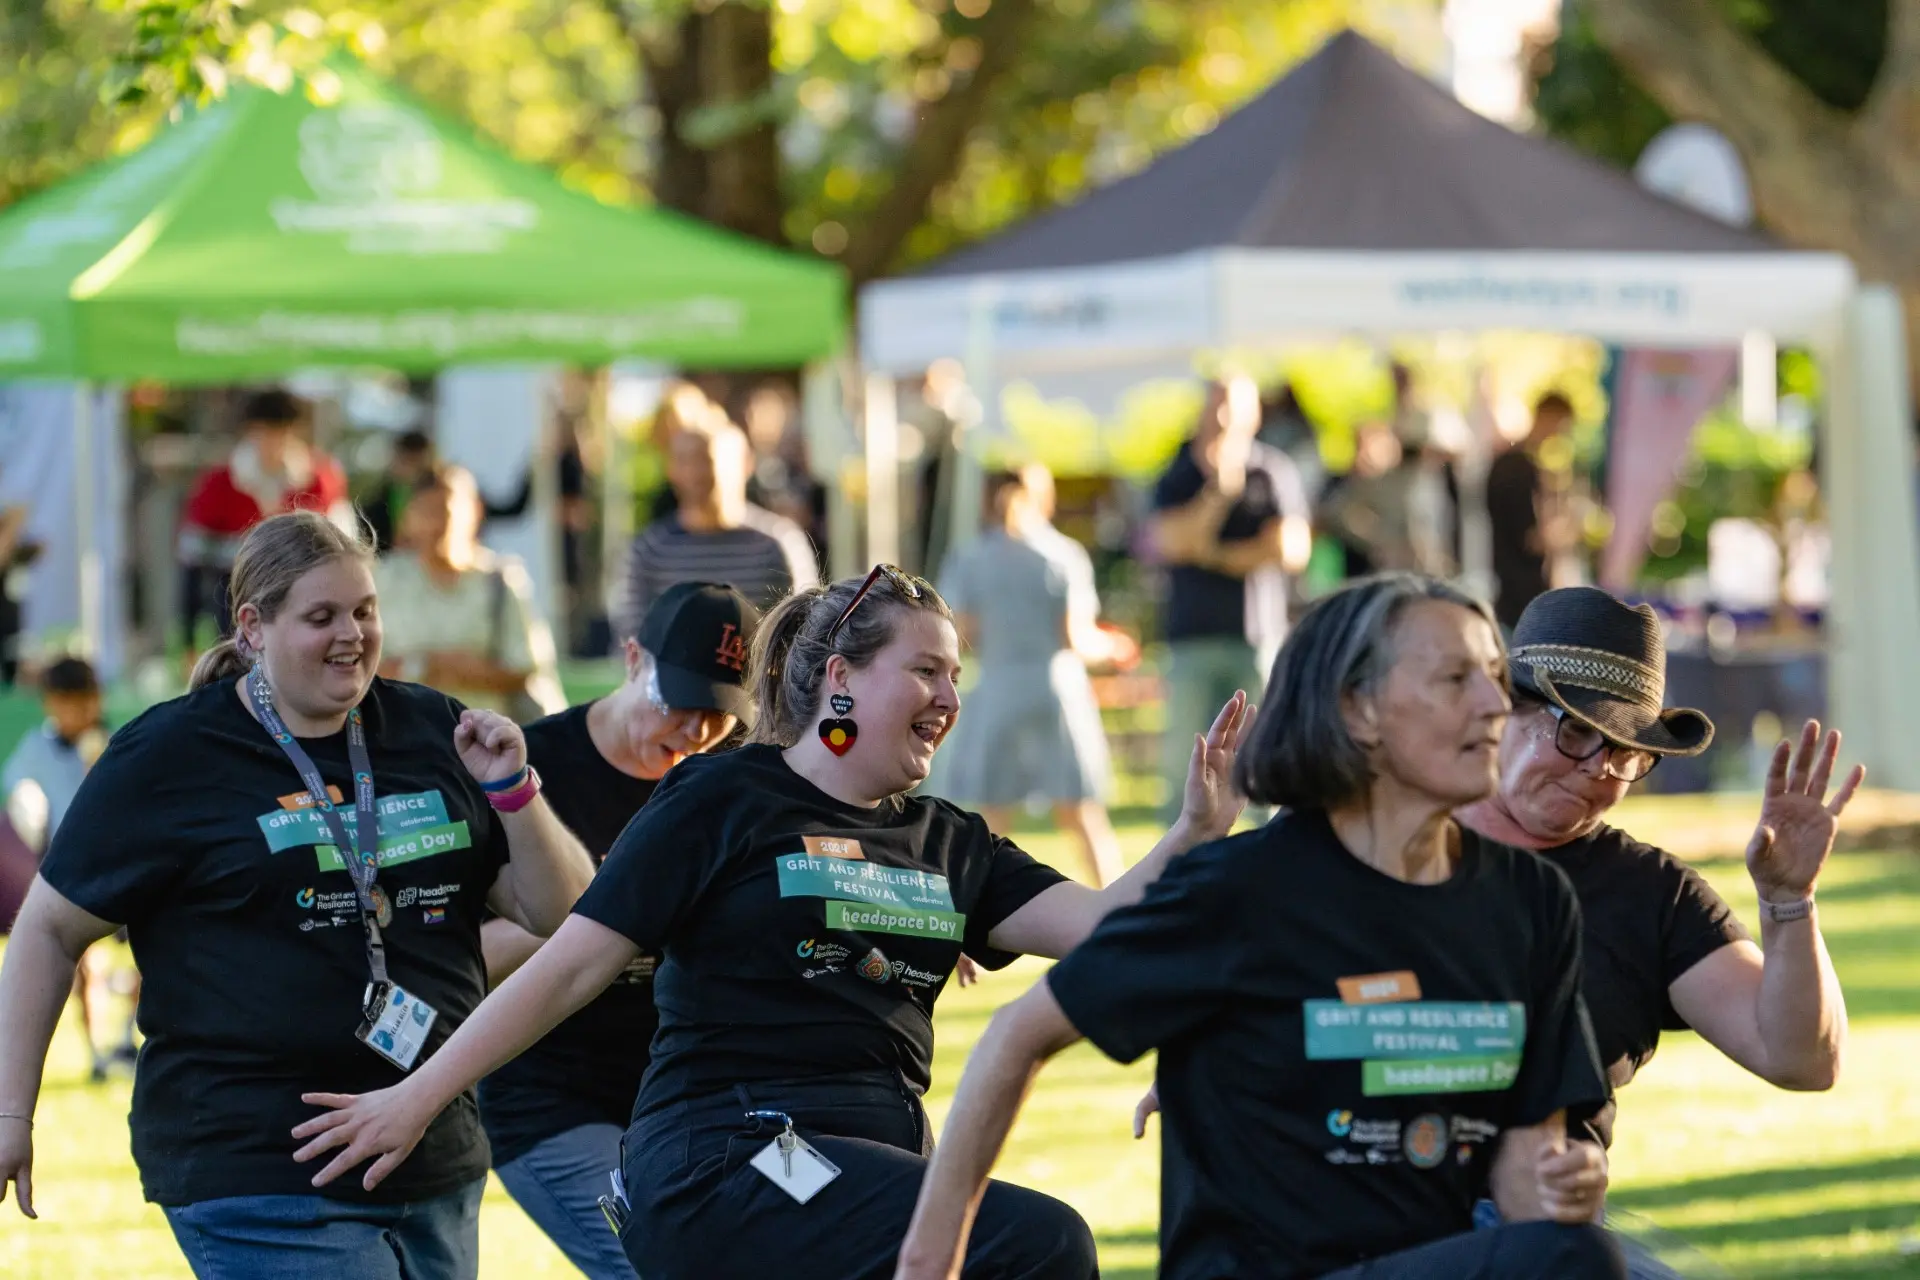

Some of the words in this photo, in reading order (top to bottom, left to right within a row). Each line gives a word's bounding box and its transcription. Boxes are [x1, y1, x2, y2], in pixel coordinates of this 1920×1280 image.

[715, 623, 745, 671] LA
[832, 698, 852, 706] ALWAYS
[835, 704, 848, 712] WAS
[269, 813, 303, 828] GRIT
[340, 798, 428, 823] REIENCE
[400, 815, 437, 828] celebrates
[332, 842, 418, 866] hpace
[421, 832, 456, 850] Day
[820, 841, 849, 854] 2024
[786, 859, 822, 872] GRIT
[828, 862, 856, 876] AND
[860, 867, 937, 890] RESILIENCE
[330, 892, 343, 900] Grit
[343, 891, 356, 899] and
[834, 880, 900, 902] FESTIVAL
[317, 901, 357, 910] Resilience
[842, 906, 925, 930] headspace
[929, 915, 956, 937] Day
[1315, 1008, 1360, 1027] GRIT
[1367, 1009, 1406, 1027] AND
[1409, 1009, 1509, 1029] RESILIENCE
[1373, 1032, 1460, 1051] FESTIVAL
[1383, 1065, 1488, 1089] headspace
